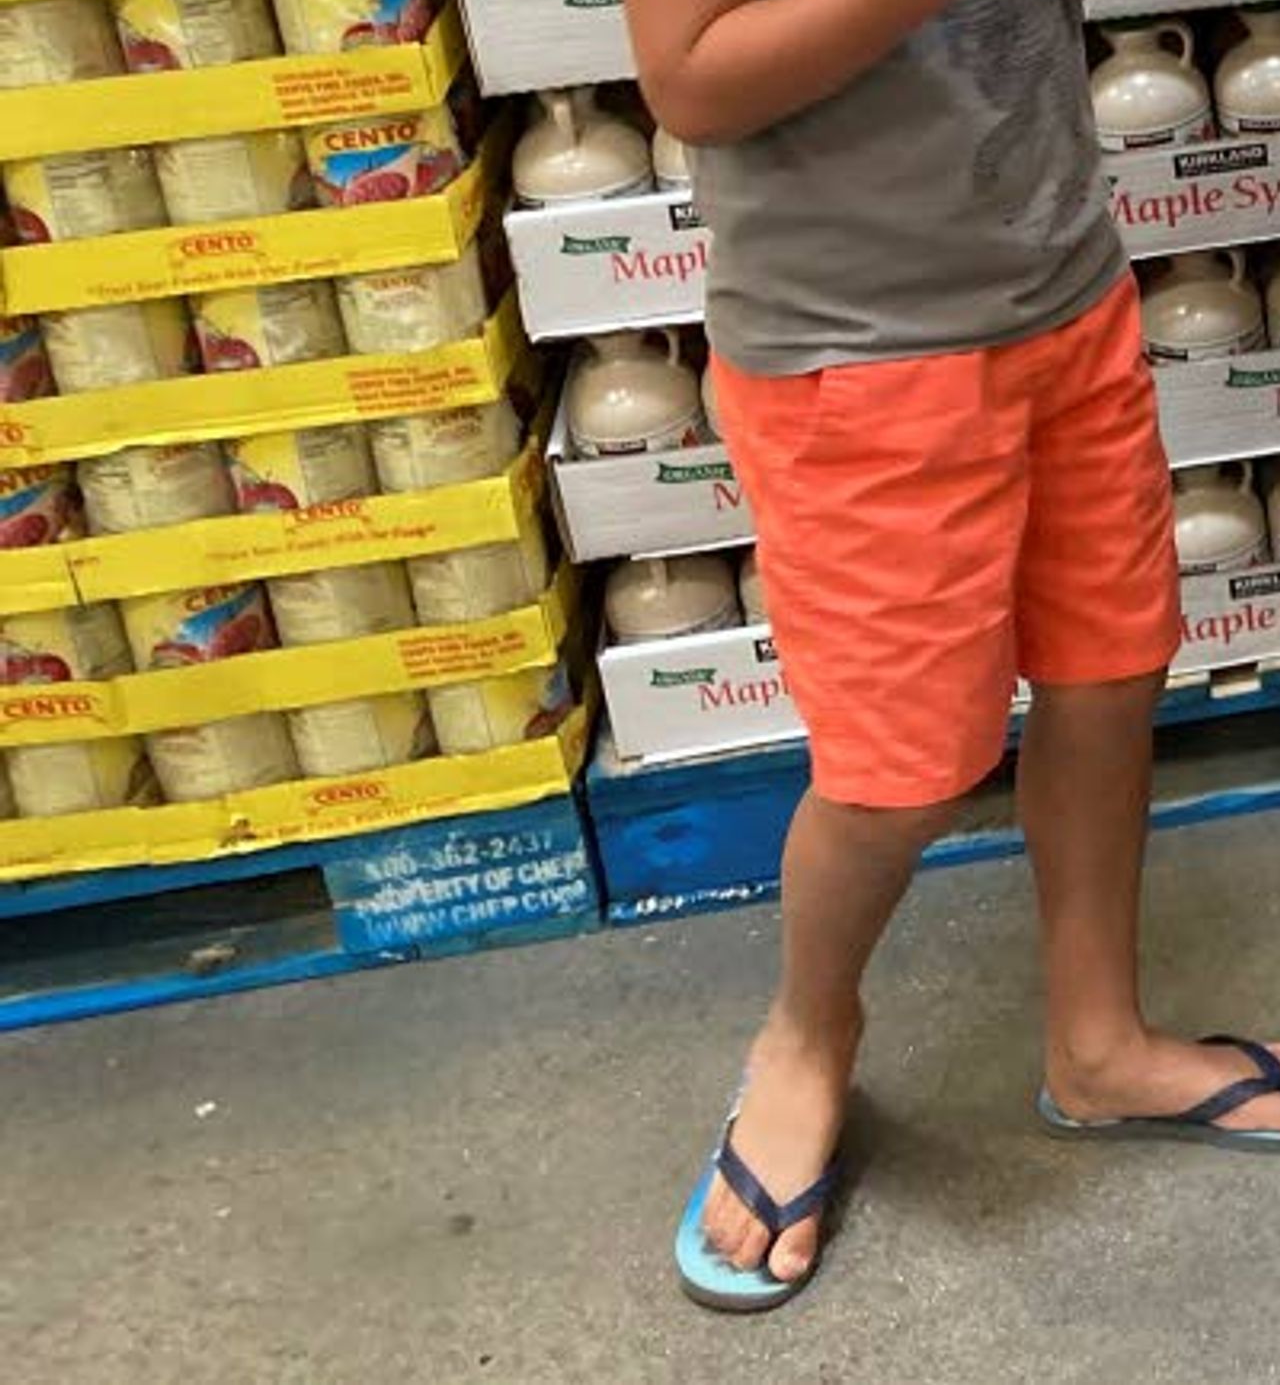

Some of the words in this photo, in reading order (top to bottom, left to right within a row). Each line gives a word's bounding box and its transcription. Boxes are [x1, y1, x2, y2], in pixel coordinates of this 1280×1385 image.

[325, 122, 417, 152] CENTO
[1179, 146, 1264, 169] KIRKLAND
[181, 233, 255, 254] CENTO
[612, 242, 707, 284] Mapl
[3, 695, 93, 718] CENTO
[314, 783, 381, 803] CENTO
[483, 866, 515, 892] OF
